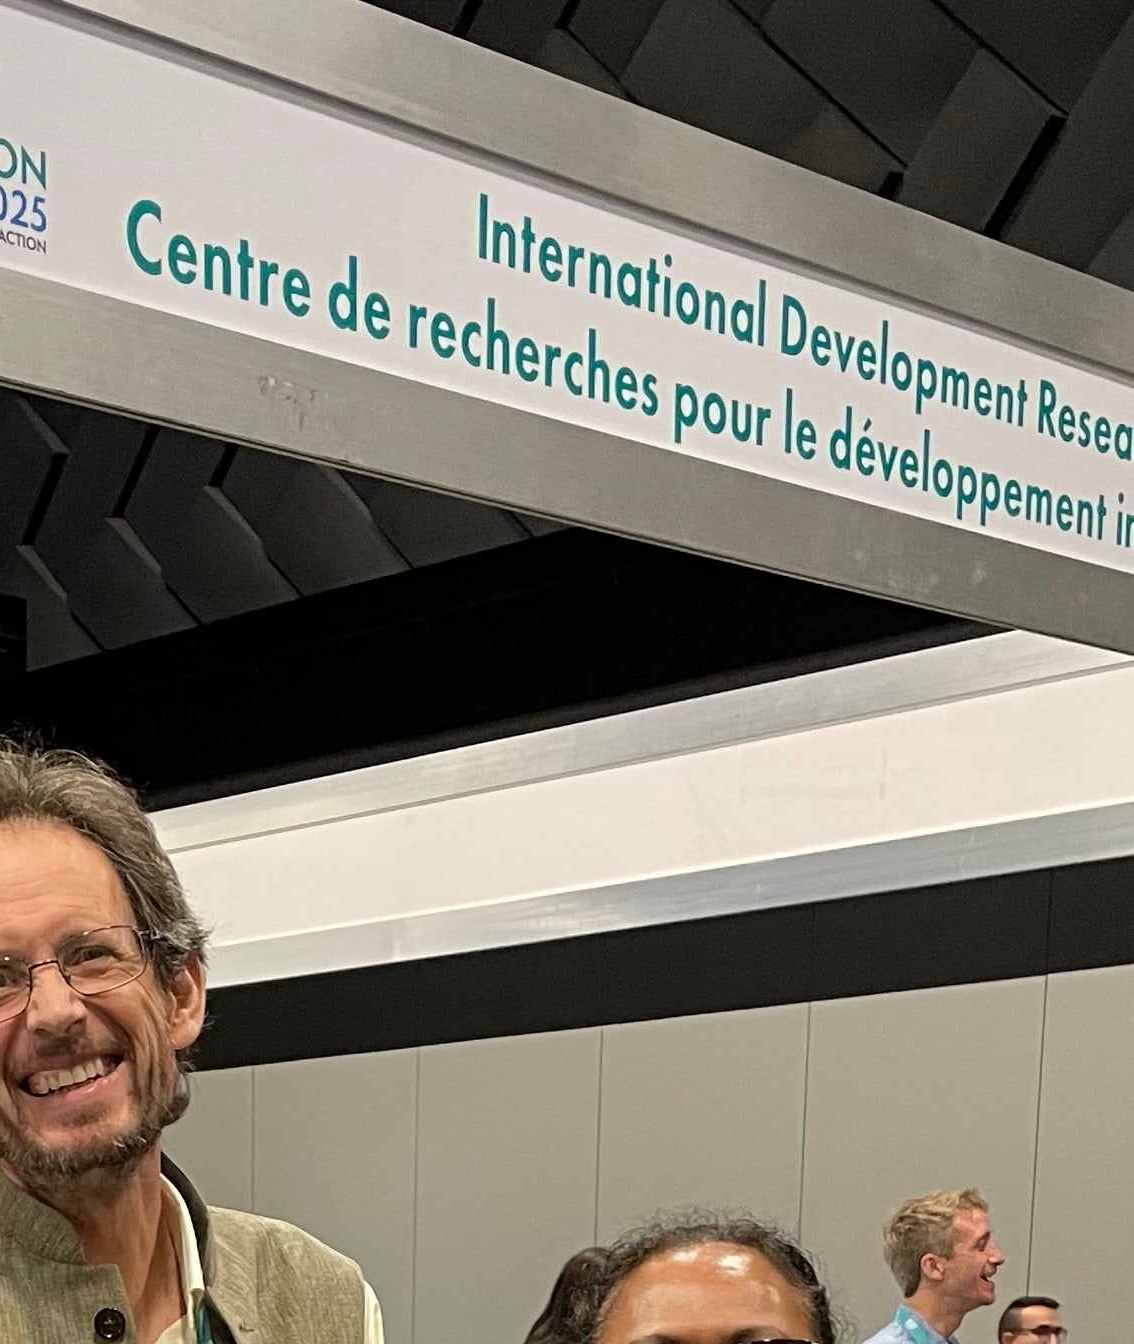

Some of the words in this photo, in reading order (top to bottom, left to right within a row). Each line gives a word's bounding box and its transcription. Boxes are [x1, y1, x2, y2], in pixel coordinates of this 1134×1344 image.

[126, 199, 311, 317] Centre
[328, 255, 391, 340] de
[409, 297, 659, 416] recherches
[674, 382, 772, 444] pour
[784, 387, 817, 460] le
[829, 405, 1107, 540] développement
[478, 193, 767, 347] International
[780, 293, 1028, 428] Development
[1038, 379, 1133, 461] Resea
